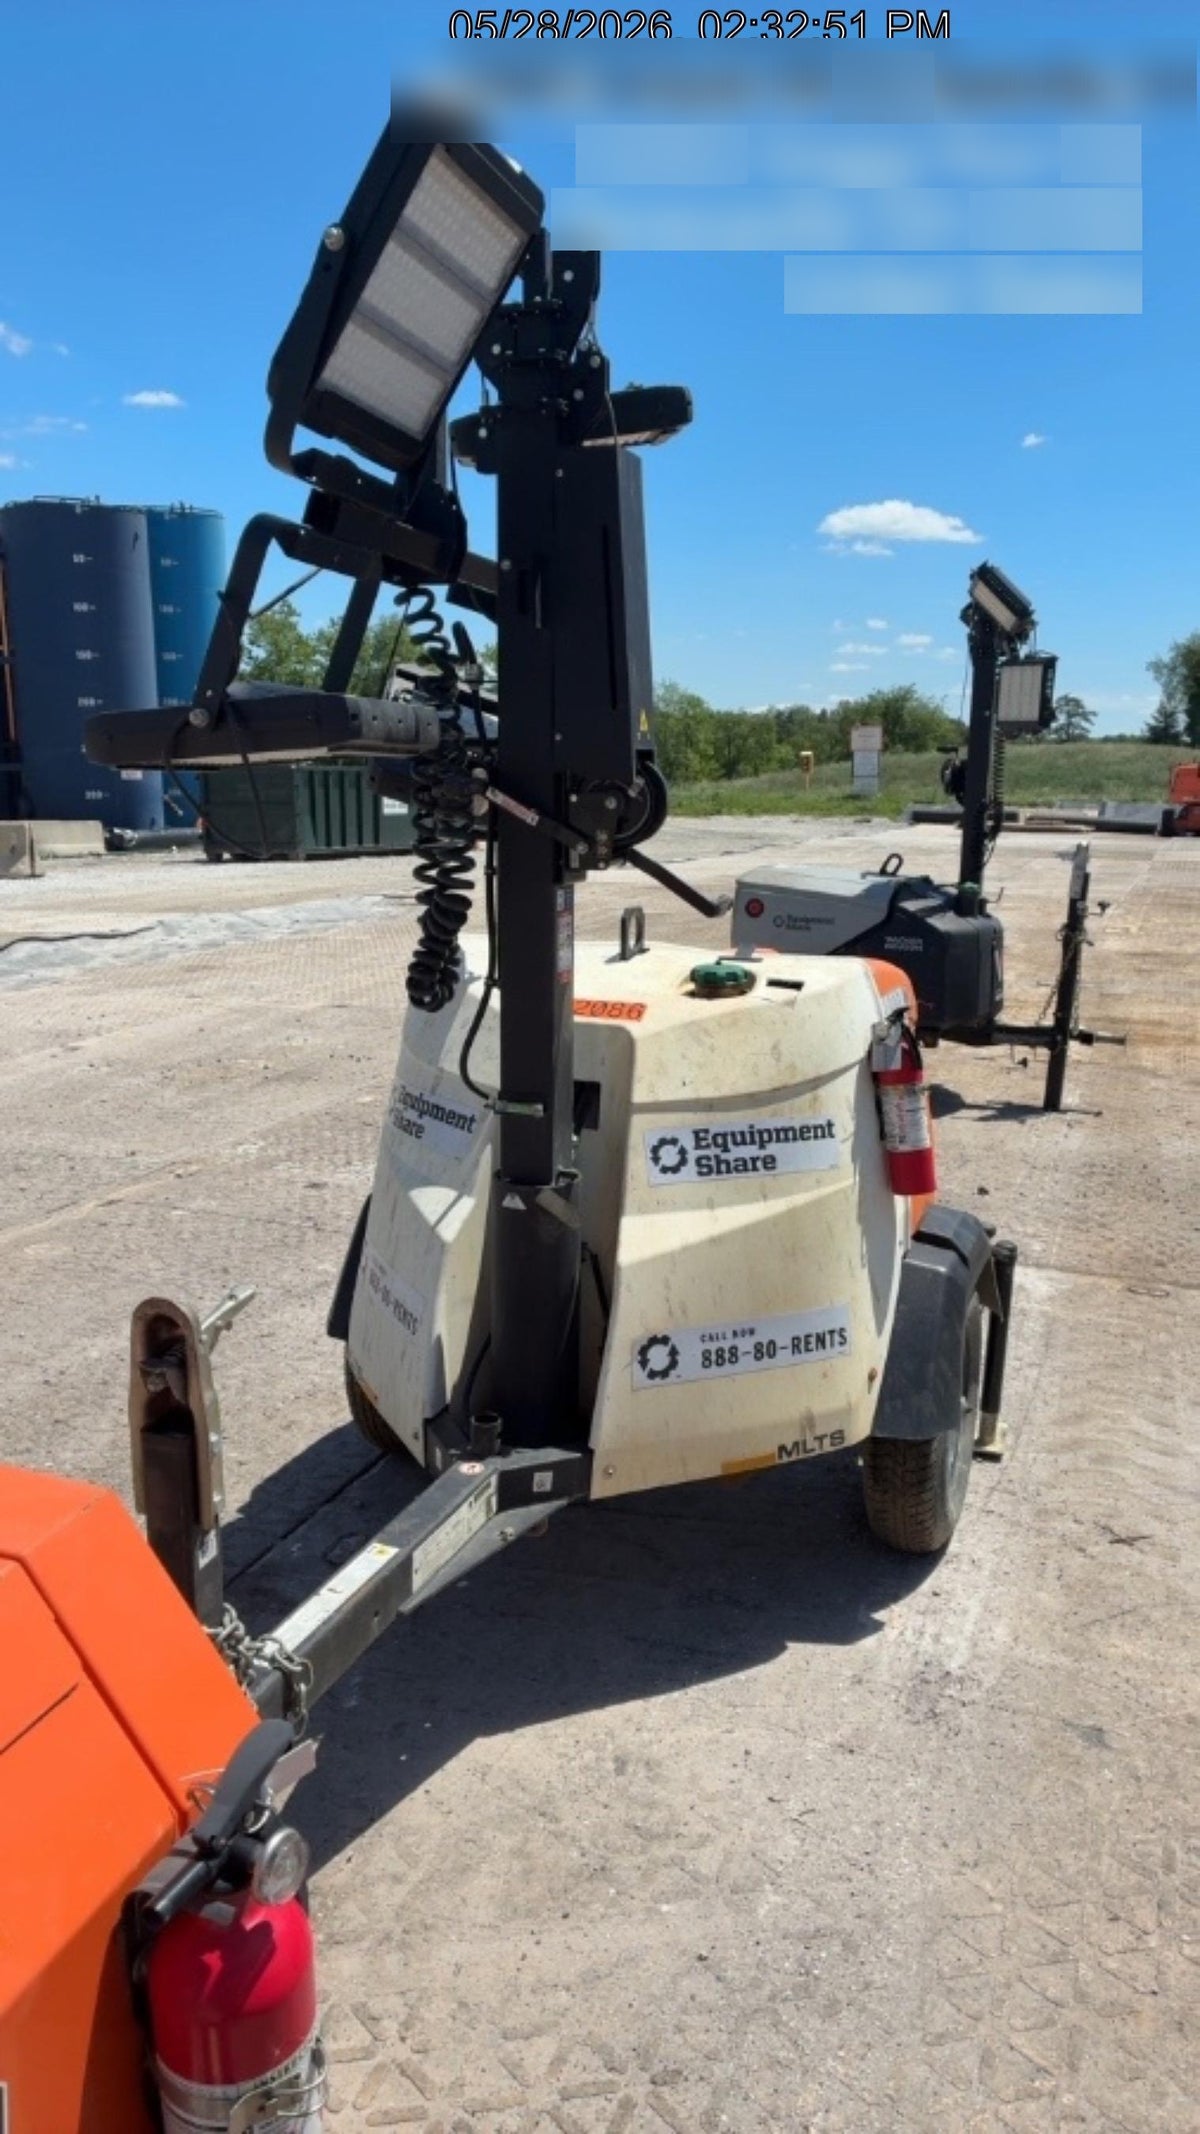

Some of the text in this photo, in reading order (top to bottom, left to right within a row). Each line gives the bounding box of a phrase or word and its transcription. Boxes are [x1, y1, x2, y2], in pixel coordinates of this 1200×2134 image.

[692, 1119, 836, 1152] Equipment
[695, 1154, 777, 1176] Share
[701, 1327, 848, 1369] 888-80-RENTS
[777, 1429, 845, 1460] MLTS
